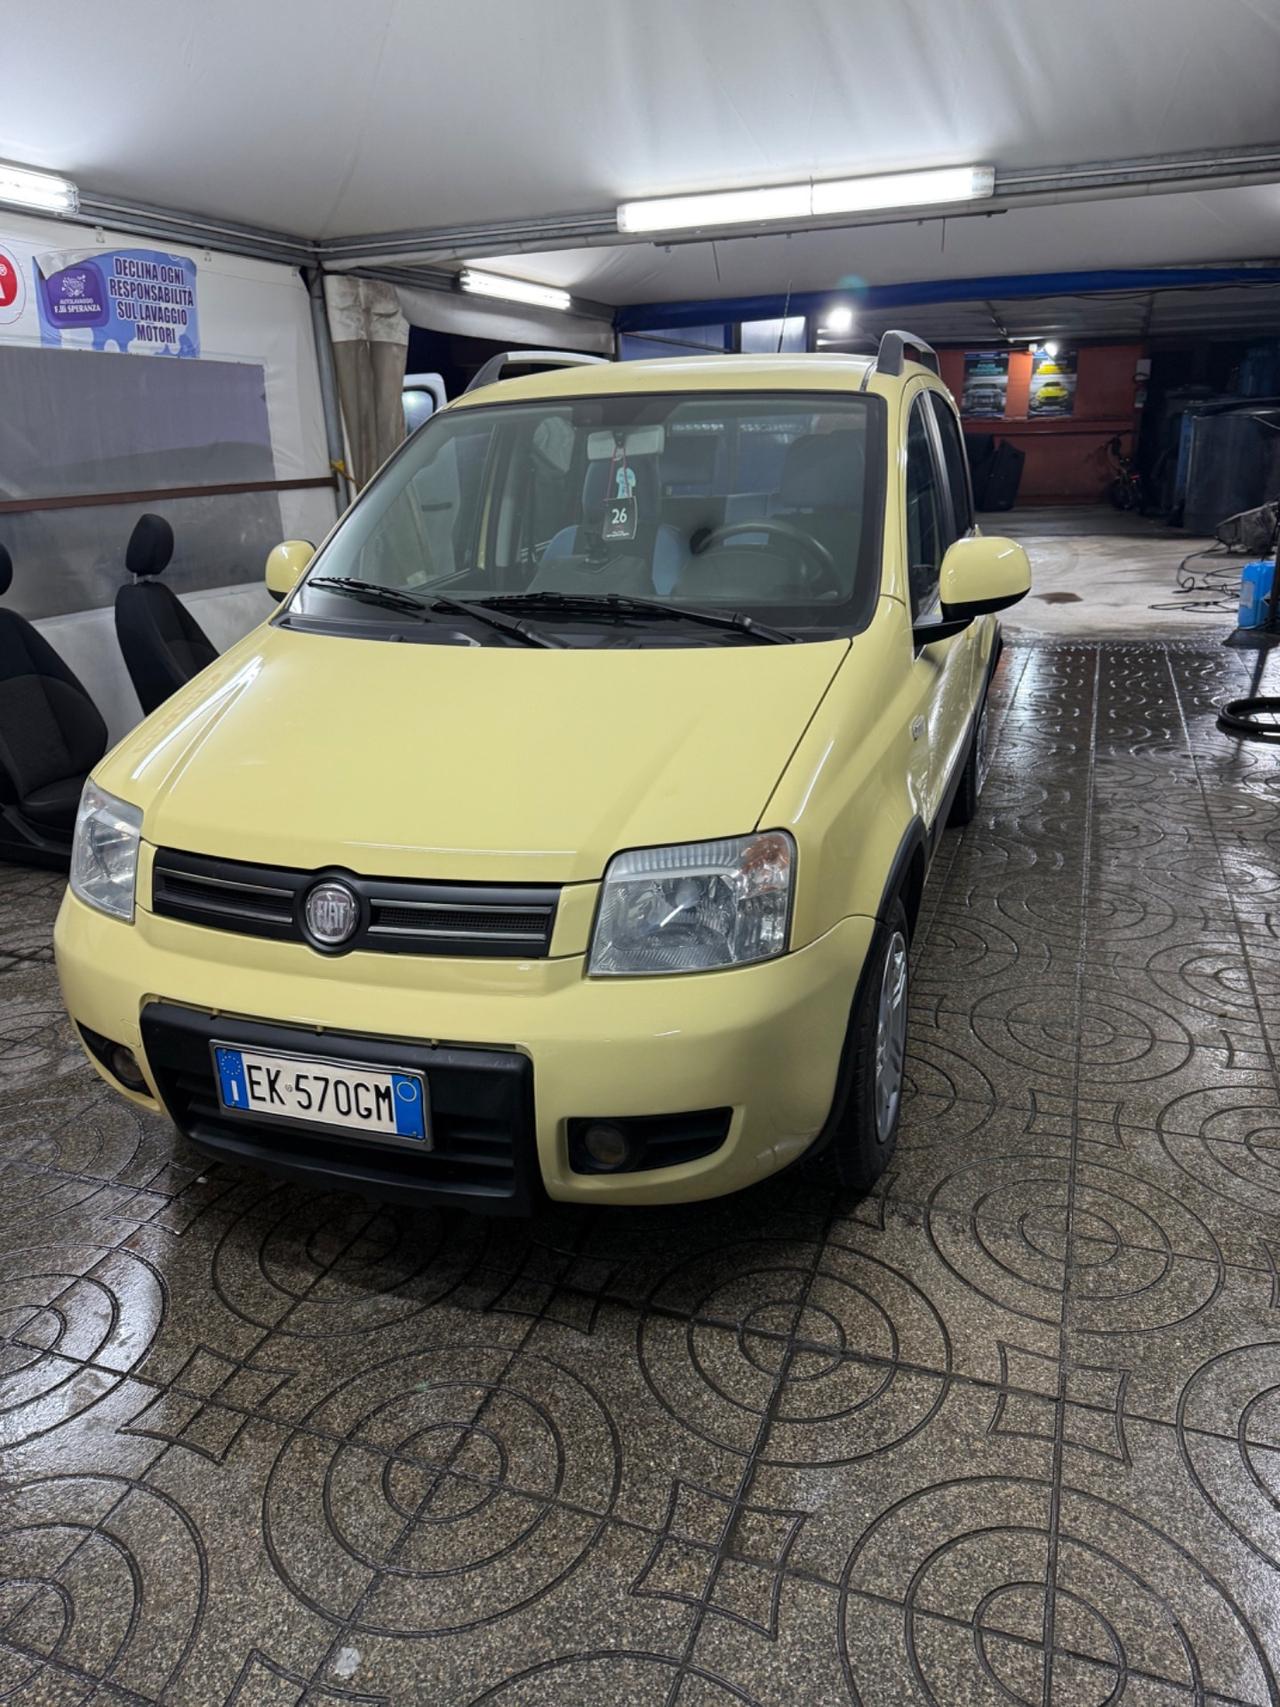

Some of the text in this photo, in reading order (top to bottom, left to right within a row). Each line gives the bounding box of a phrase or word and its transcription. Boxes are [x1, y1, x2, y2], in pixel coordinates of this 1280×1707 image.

[114, 258, 185, 286] DECLINA OGNI
[67, 304, 101, 313] SPERANZA
[117, 301, 188, 326] SUL LAVAGGIO
[136, 323, 176, 344] MOTORI
[611, 507, 628, 524] 26
[315, 900, 347, 929] FIAT
